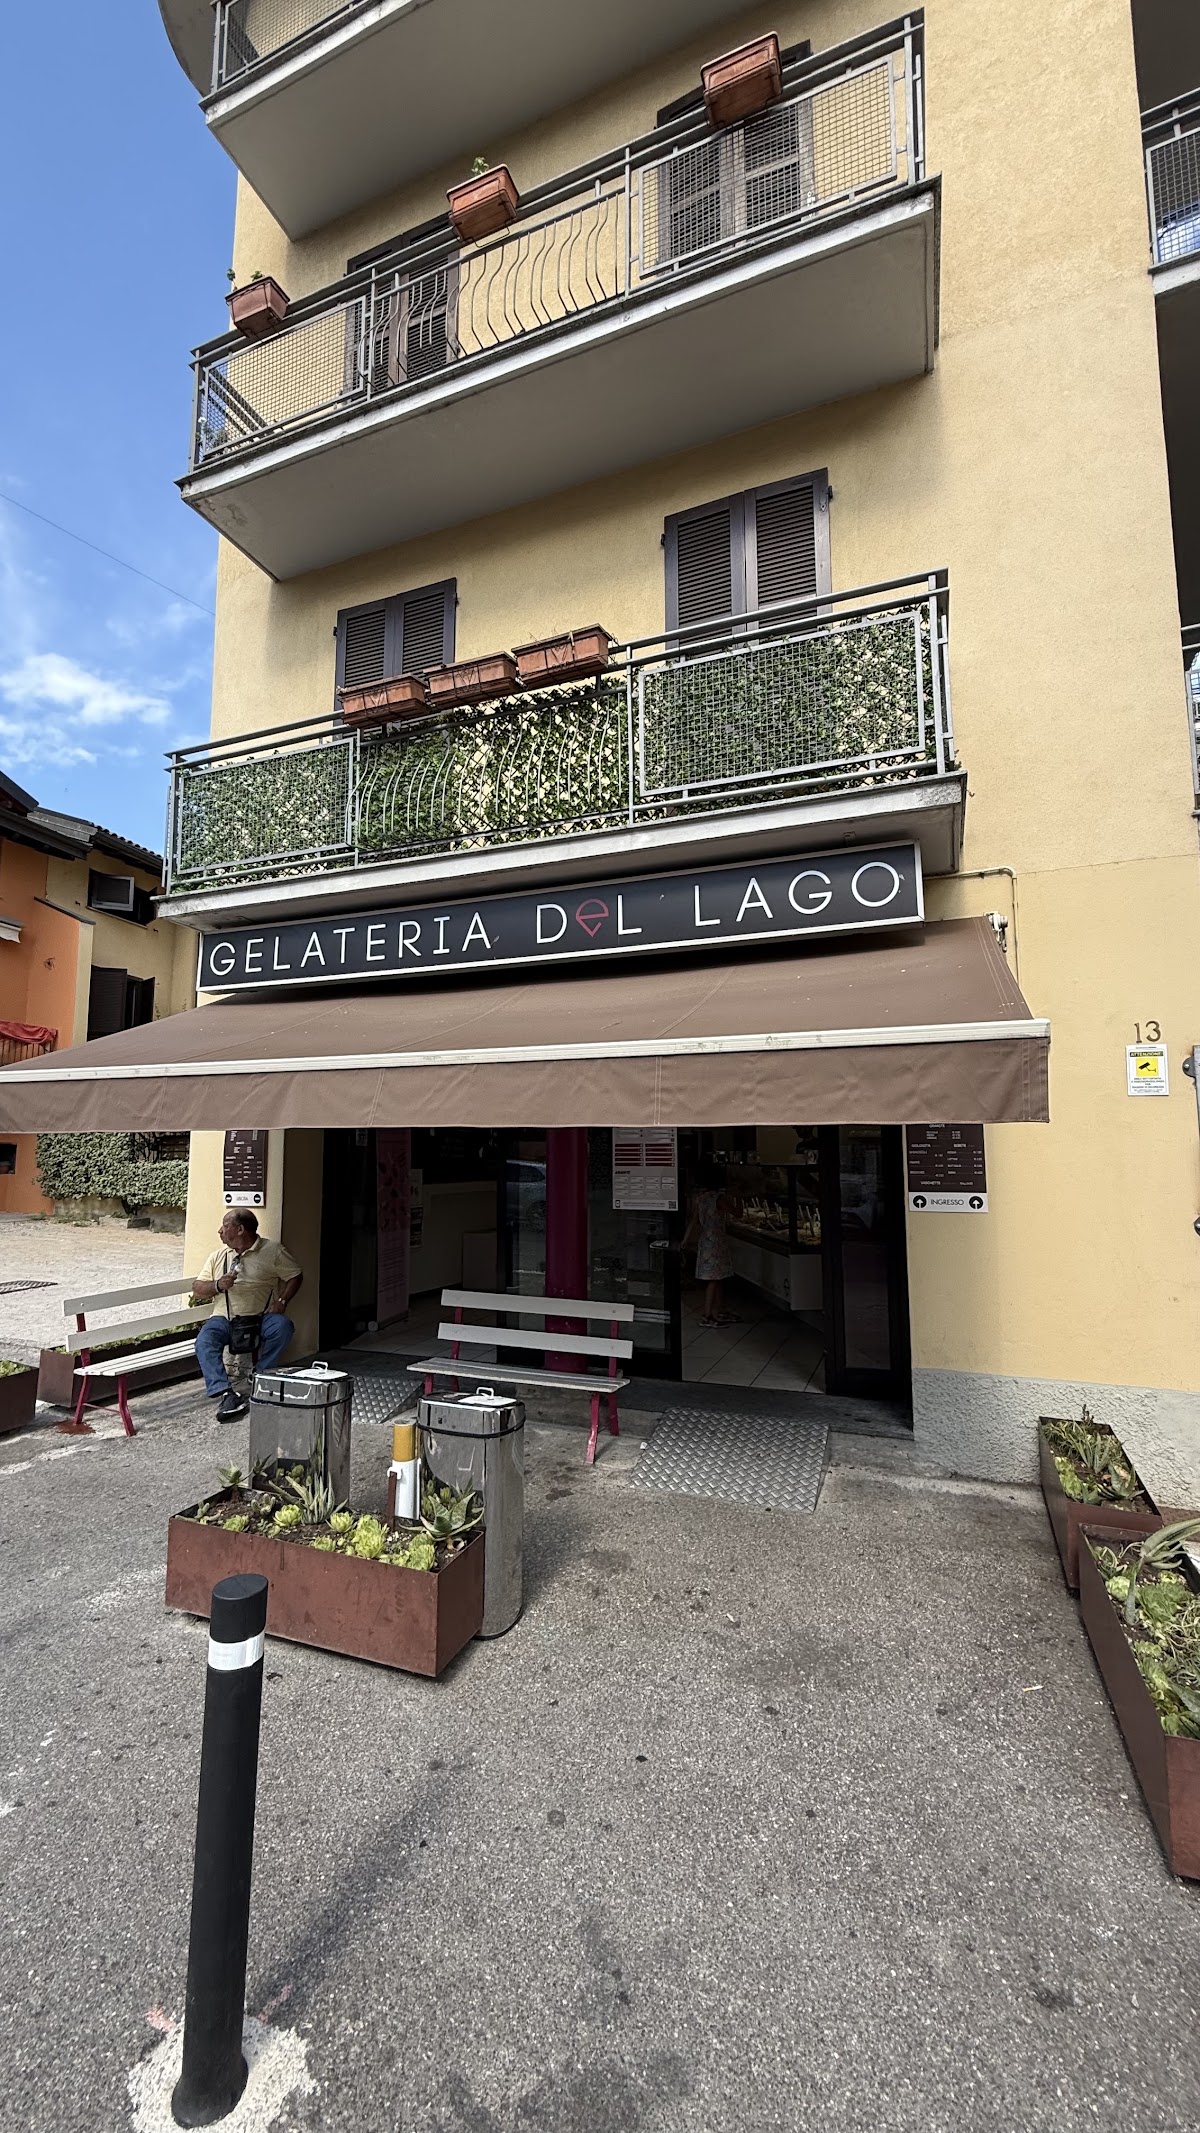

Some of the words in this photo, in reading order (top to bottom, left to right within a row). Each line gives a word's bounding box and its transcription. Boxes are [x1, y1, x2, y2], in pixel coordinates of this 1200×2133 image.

[209, 911, 492, 976] GELATERIA
[694, 861, 906, 927] LAGO
[1133, 1020, 1161, 1044] 13
